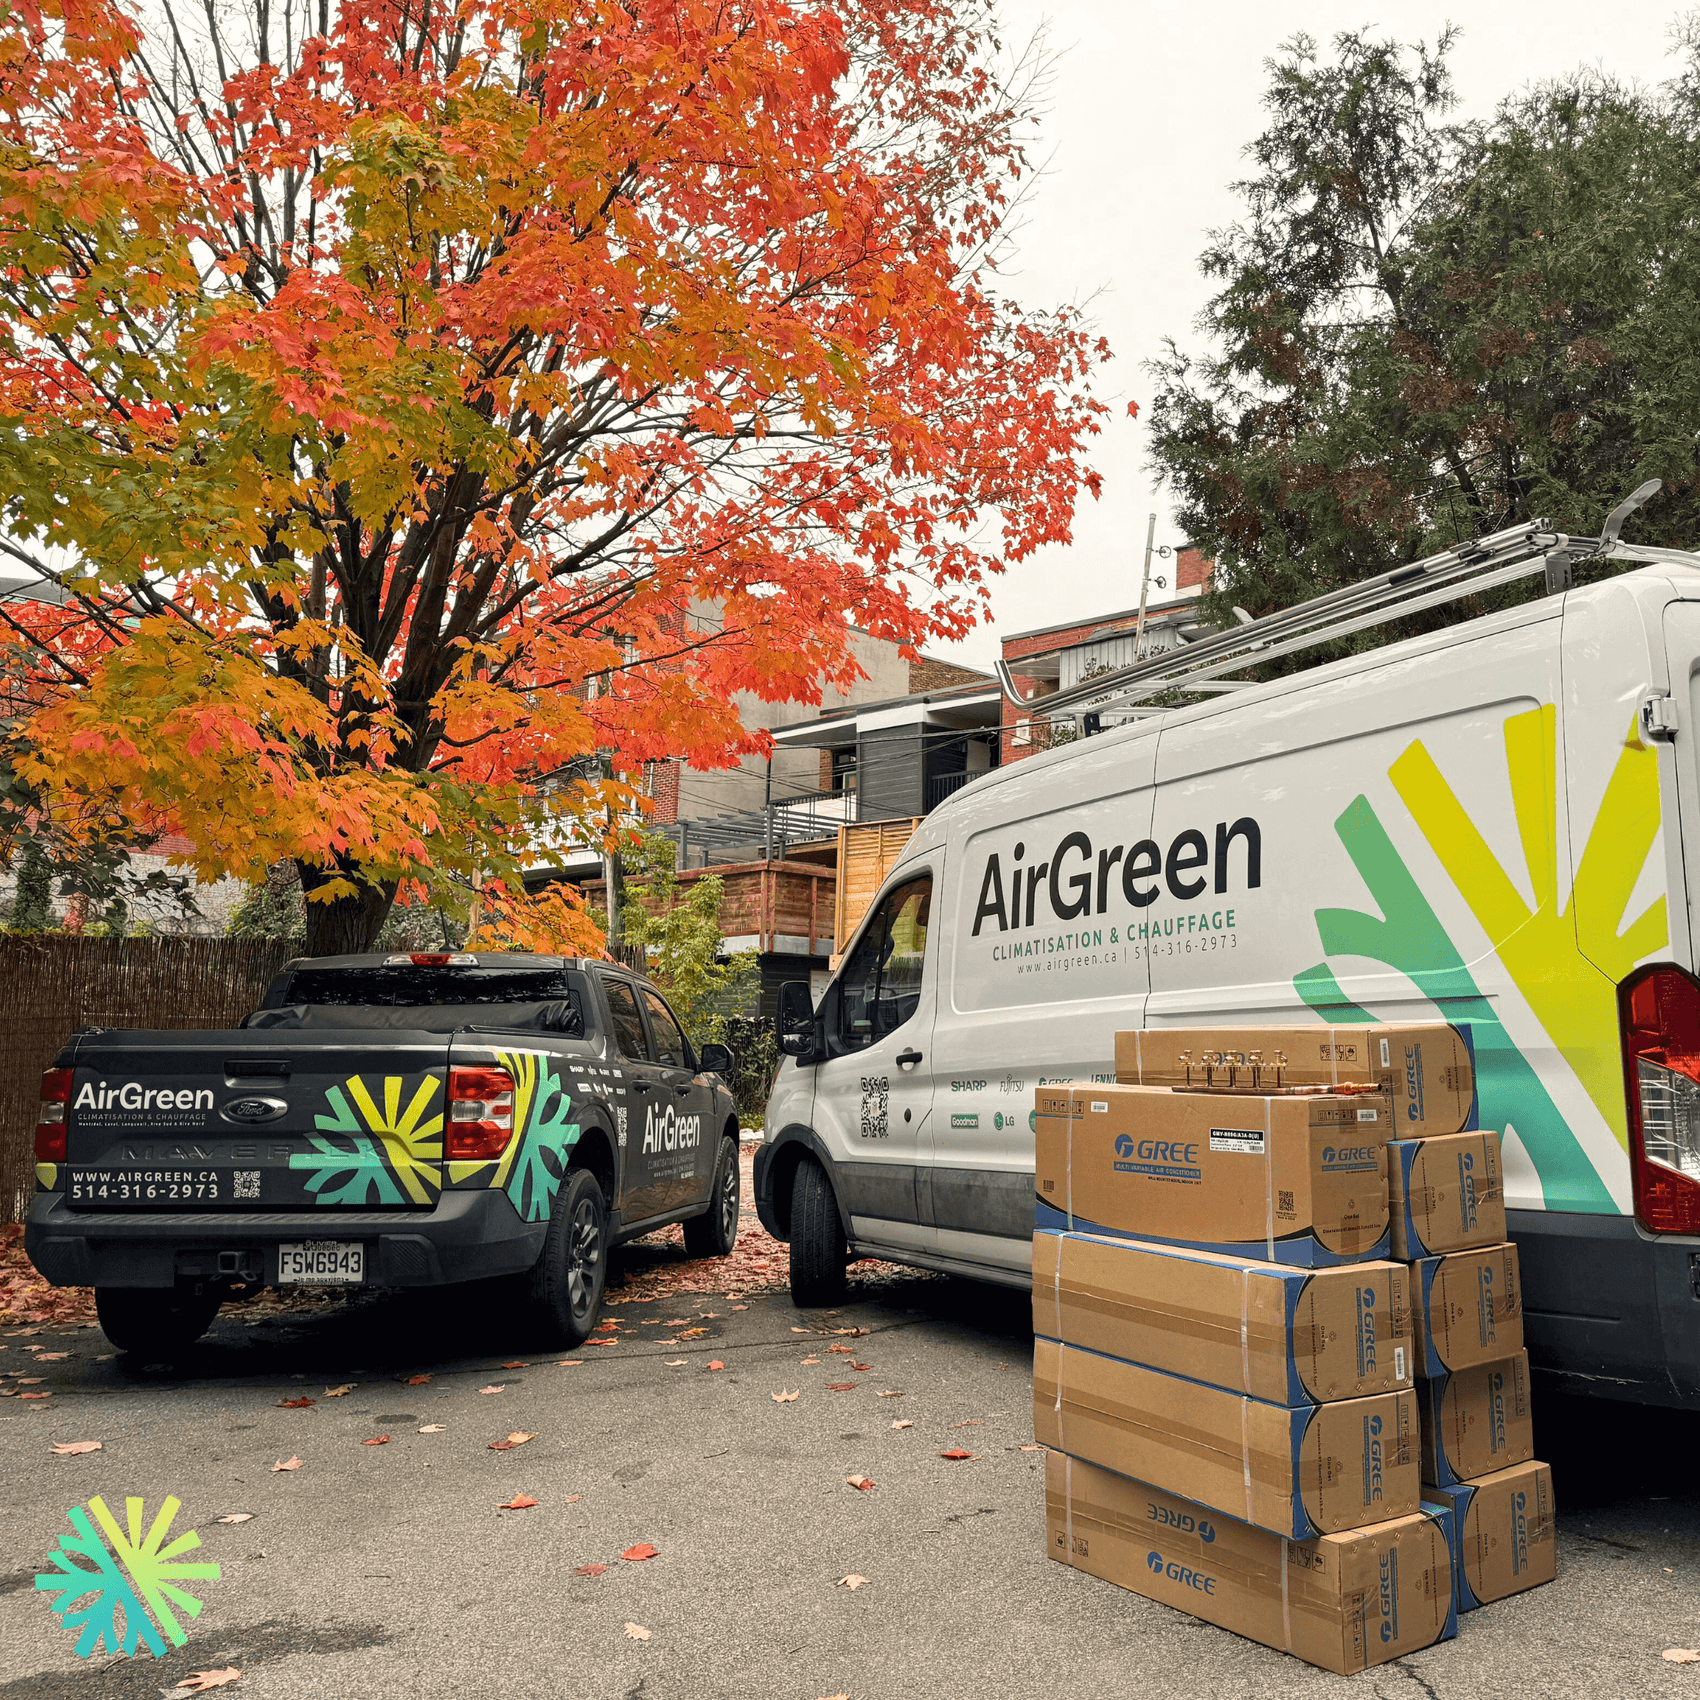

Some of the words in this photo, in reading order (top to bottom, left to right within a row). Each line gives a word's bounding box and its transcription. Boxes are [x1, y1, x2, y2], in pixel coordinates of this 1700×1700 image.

[971, 817, 1261, 937] AirGreen
[993, 927, 1102, 961] CLIMATISATION
[1110, 926, 1119, 944] &
[1127, 909, 1236, 941] CHAUFFAGE
[1017, 951, 1117, 974] www.airgreen.ca
[1135, 934, 1238, 960] 514-316-2973
[951, 1080, 987, 1092] SHARP
[1000, 1074, 1025, 1096] FUJITSU
[1404, 1046, 1417, 1100] GREE
[73, 1081, 215, 1110] AirGreen
[237, 1102, 265, 1115] Ford
[642, 1101, 700, 1154] AirGreen
[952, 1116, 978, 1127] Goodman
[1005, 1116, 1015, 1127] LG
[1137, 1140, 1199, 1164] GREE
[1338, 1147, 1376, 1161] GREE
[72, 1172, 218, 1182] WWW.AIRGREEN.CA
[72, 1184, 219, 1199] 514-316-2973
[1465, 1174, 1478, 1230] GREE
[281, 1252, 361, 1274] FSW6943
[1485, 1289, 1496, 1343] GREE
[1364, 1312, 1376, 1373] GREE
[1494, 1395, 1506, 1449] GREE
[1371, 1440, 1383, 1501] GREE
[1147, 1503, 1196, 1533] GREE
[1517, 1514, 1528, 1571] GREE
[1165, 1562, 1217, 1596] GREE
[1379, 1554, 1390, 1617] GREE
